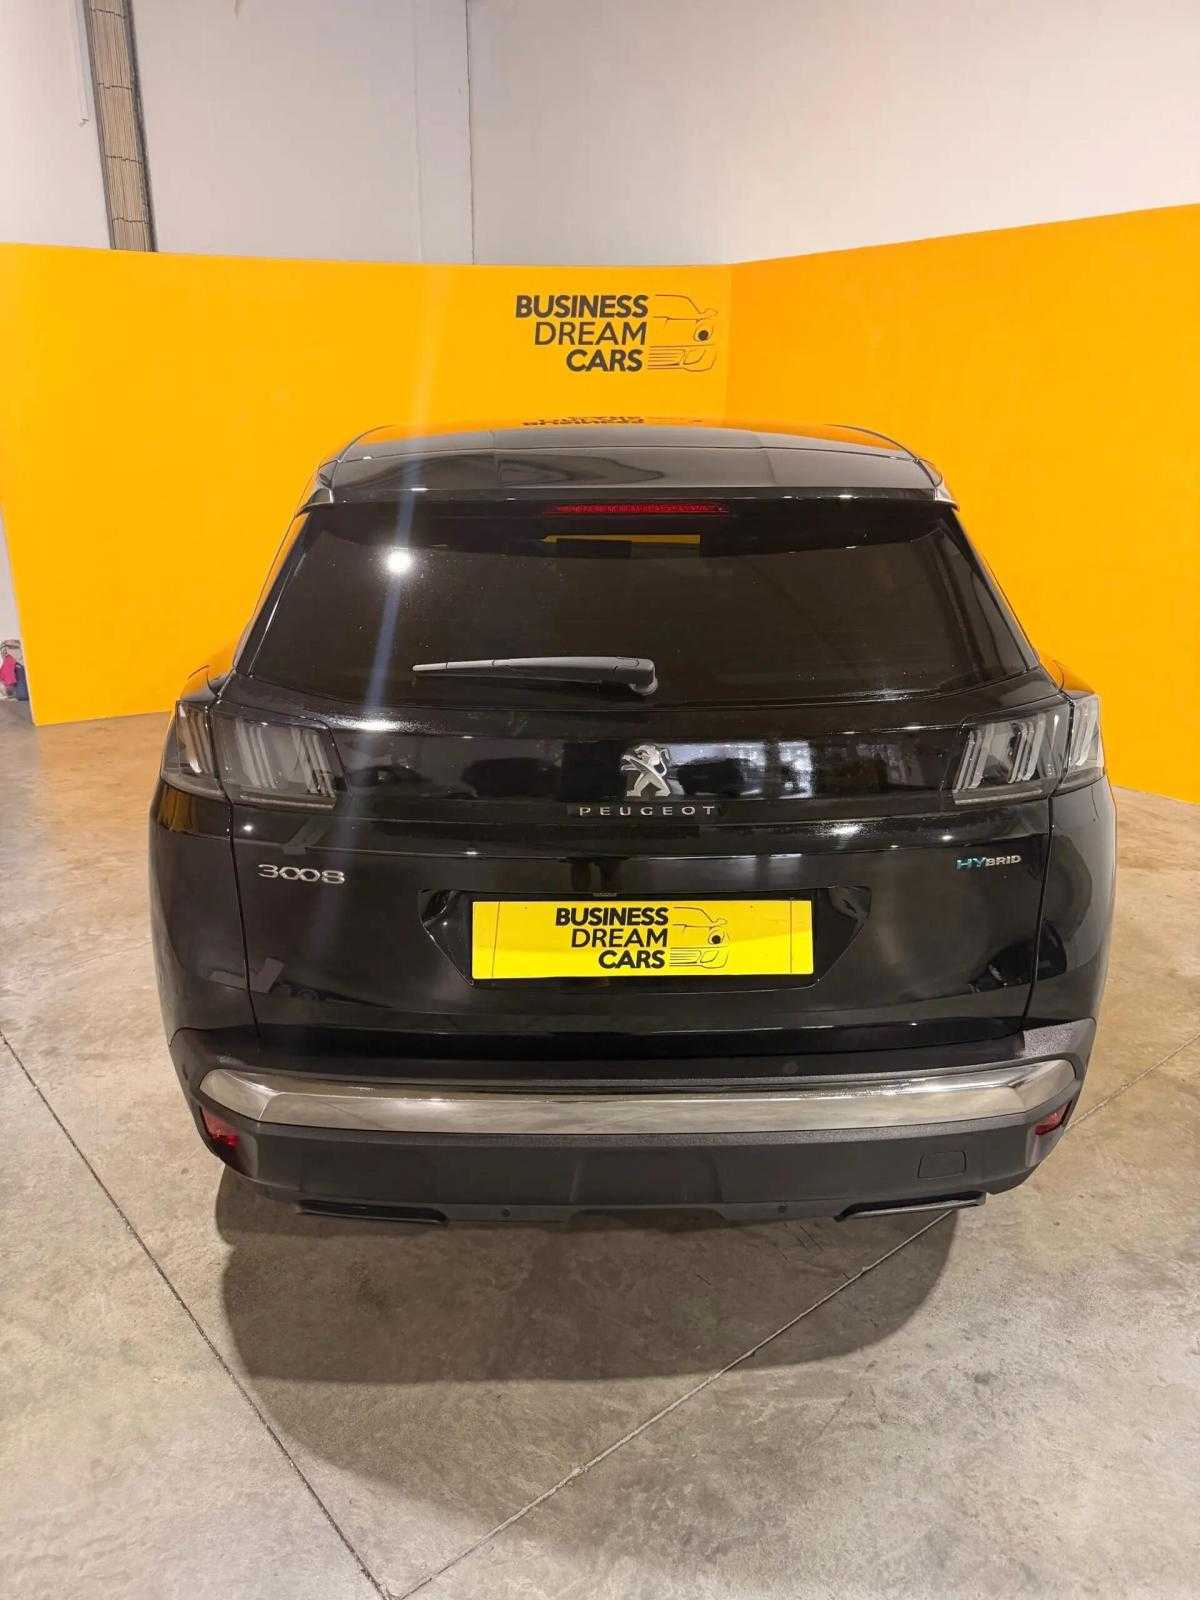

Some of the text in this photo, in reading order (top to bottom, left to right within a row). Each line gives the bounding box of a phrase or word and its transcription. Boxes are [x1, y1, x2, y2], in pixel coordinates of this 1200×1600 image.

[515, 295, 649, 318] BUSINESS
[534, 321, 647, 346] DREAM
[566, 349, 643, 372] CARS
[579, 806, 716, 816] PEUGEOT
[956, 854, 1022, 870] HYBRID
[257, 864, 345, 884] 3008
[555, 907, 669, 926] BUSINESS
[571, 928, 668, 948] DREAM
[598, 949, 665, 969] CARS
